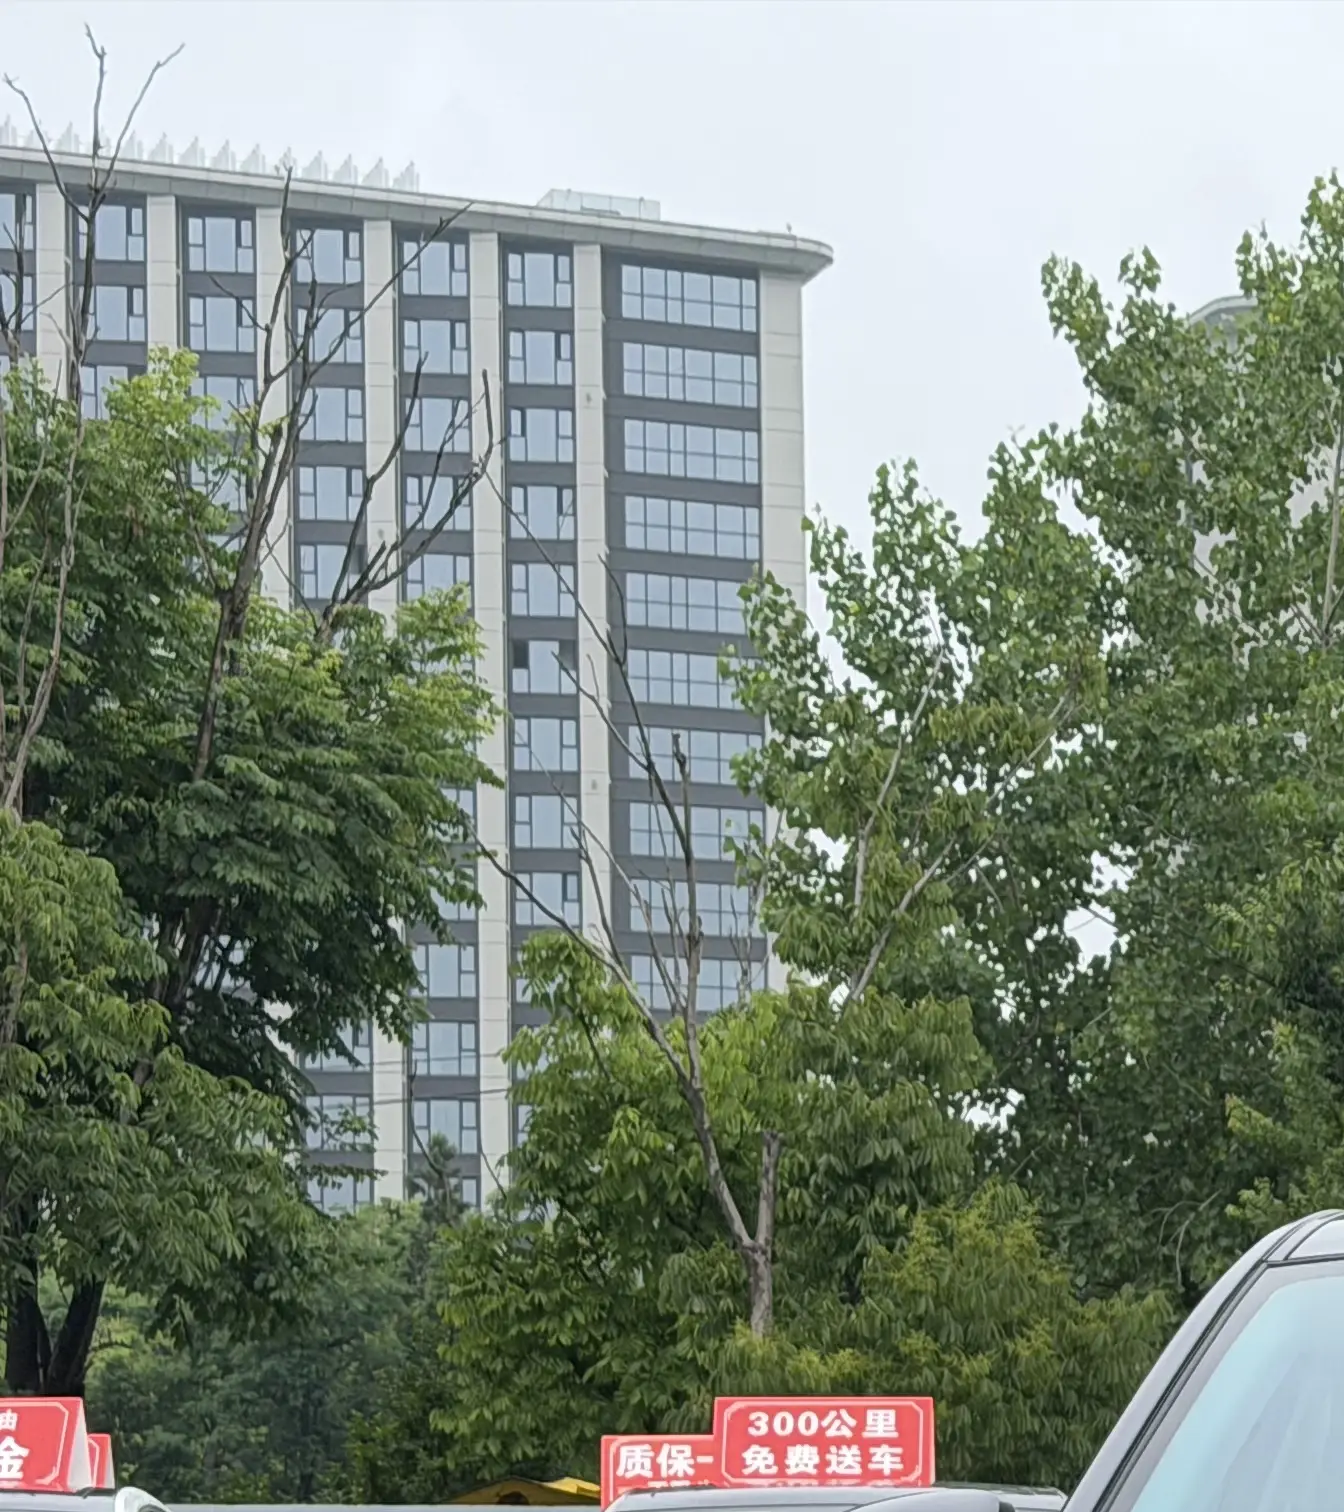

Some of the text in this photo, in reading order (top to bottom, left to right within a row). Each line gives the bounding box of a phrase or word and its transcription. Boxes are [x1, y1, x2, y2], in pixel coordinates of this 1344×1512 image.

[748, 1409, 899, 1438] 300公里
[0, 1436, 30, 1479] 金
[741, 1445, 904, 1476] 免费送车
